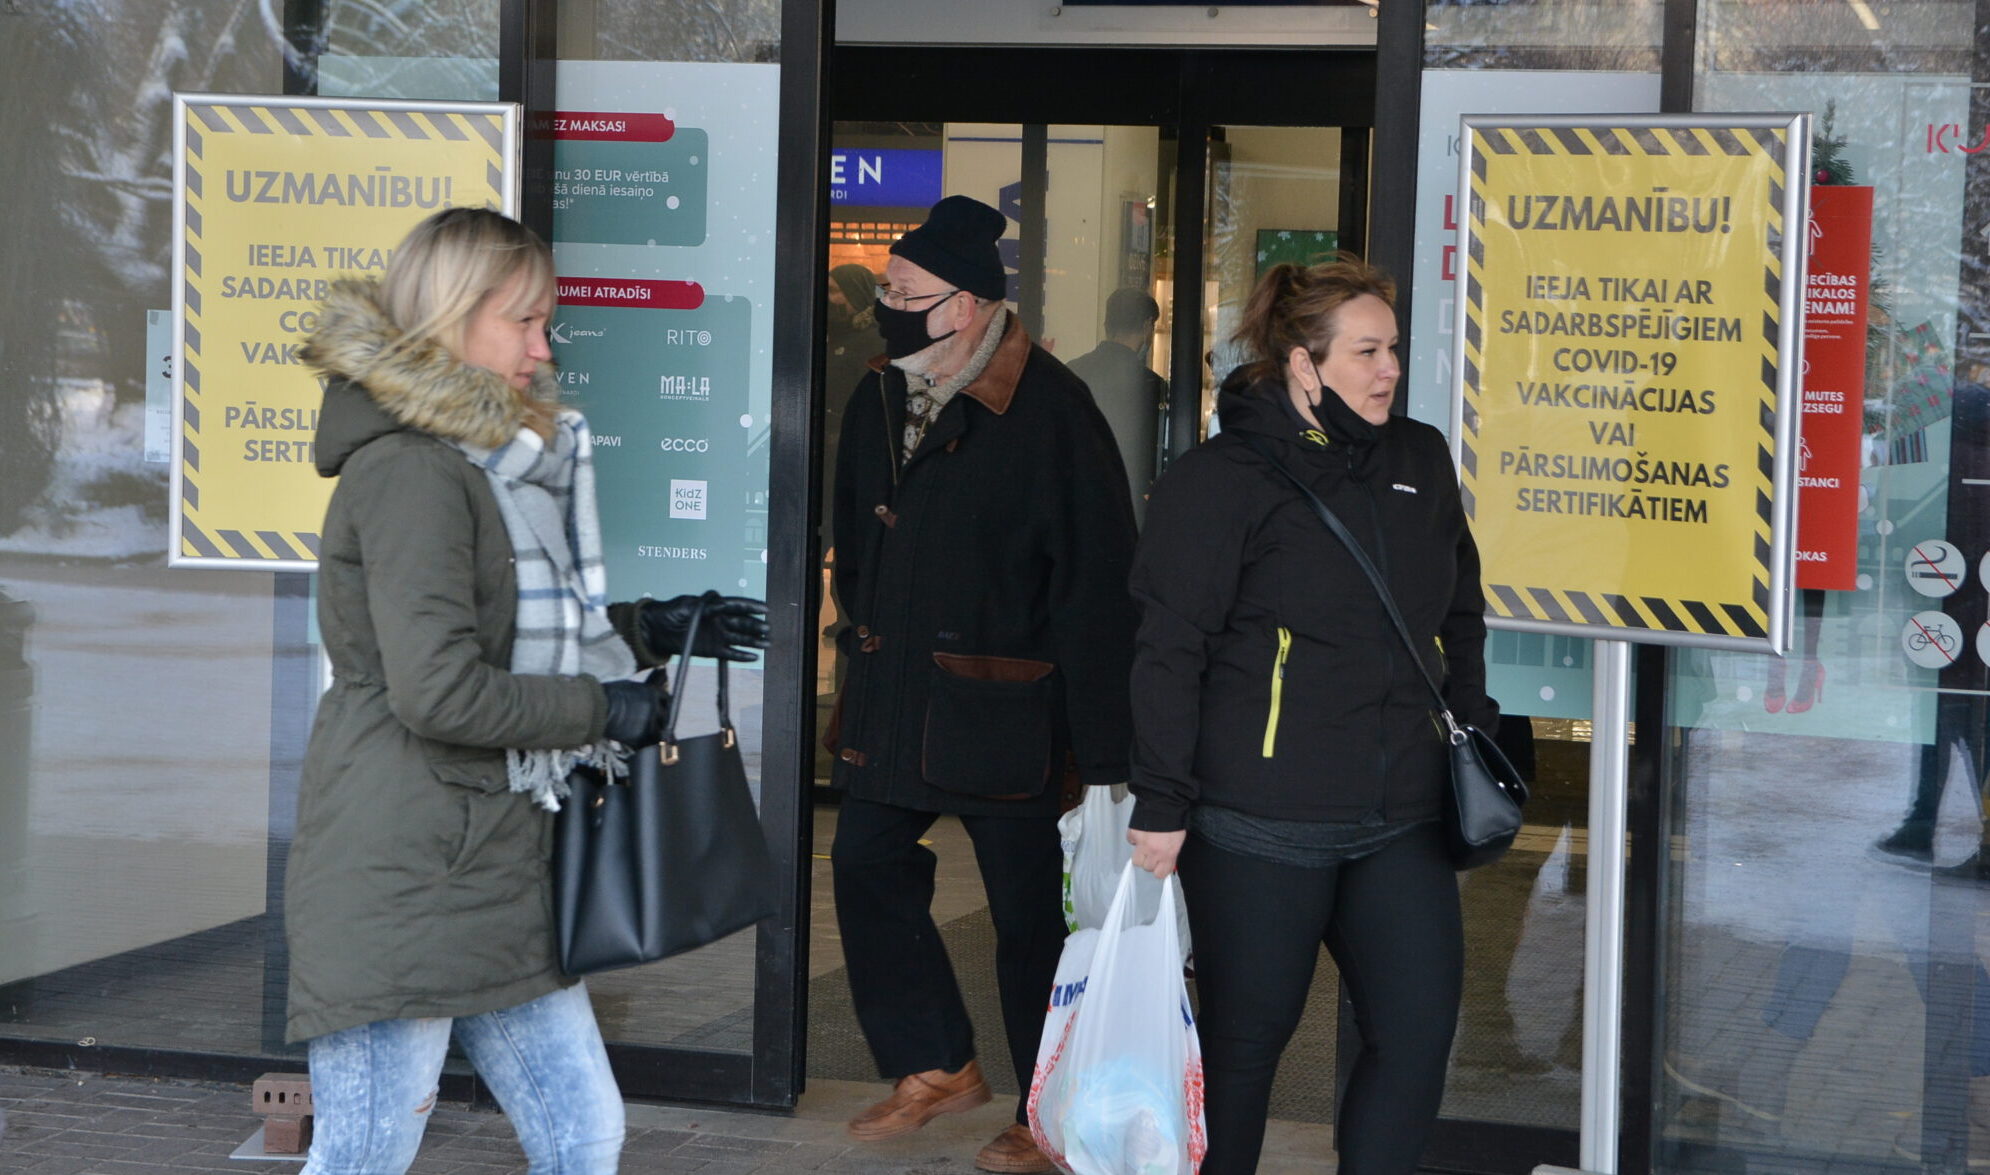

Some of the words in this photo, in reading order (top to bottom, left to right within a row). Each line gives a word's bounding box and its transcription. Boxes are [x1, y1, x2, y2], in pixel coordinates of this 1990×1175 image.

[554, 120, 567, 131] EZ
[570, 121, 626, 133] MAKSAS!
[555, 170, 570, 180] nu
[574, 169, 591, 181] 30
[595, 170, 621, 182] EUR
[625, 170, 669, 183] vērtībā
[831, 155, 882, 185] EN
[226, 166, 452, 209] UZMANĪBU!
[554, 183, 568, 195] šā
[572, 183, 606, 196] dienā
[610, 185, 654, 200] iesaiņo
[831, 189, 848, 200] RDI
[1507, 187, 1731, 234] UZMANĪBU!
[248, 243, 318, 268] IEEJA
[221, 276, 330, 301] SADARB
[1526, 275, 1590, 301] IEEJA
[1597, 277, 1667, 303] TIKAI
[1675, 280, 1713, 305] AR
[1807, 287, 1857, 299] IKALOS
[1500, 306, 1743, 342] SADARBSPĒJĪGIEM
[667, 329, 712, 346] RITO
[240, 342, 300, 366] VAK
[1553, 347, 1677, 377] COVID-19
[555, 372, 590, 385] VEN
[1516, 380, 1716, 415] VAKCINĀCIJAS
[1802, 403, 1843, 414] ZSEGU
[1805, 391, 1845, 402] MUTES
[225, 401, 317, 432] PĀRSLI
[1589, 421, 1636, 446] VAI
[244, 439, 315, 464] SERTI
[1500, 446, 1730, 489] PĀRSLIMOŠANAS
[675, 500, 702, 512] ONE
[1516, 484, 1708, 524] SERTIFIKĀTIEM
[638, 545, 707, 560] STENDERS
